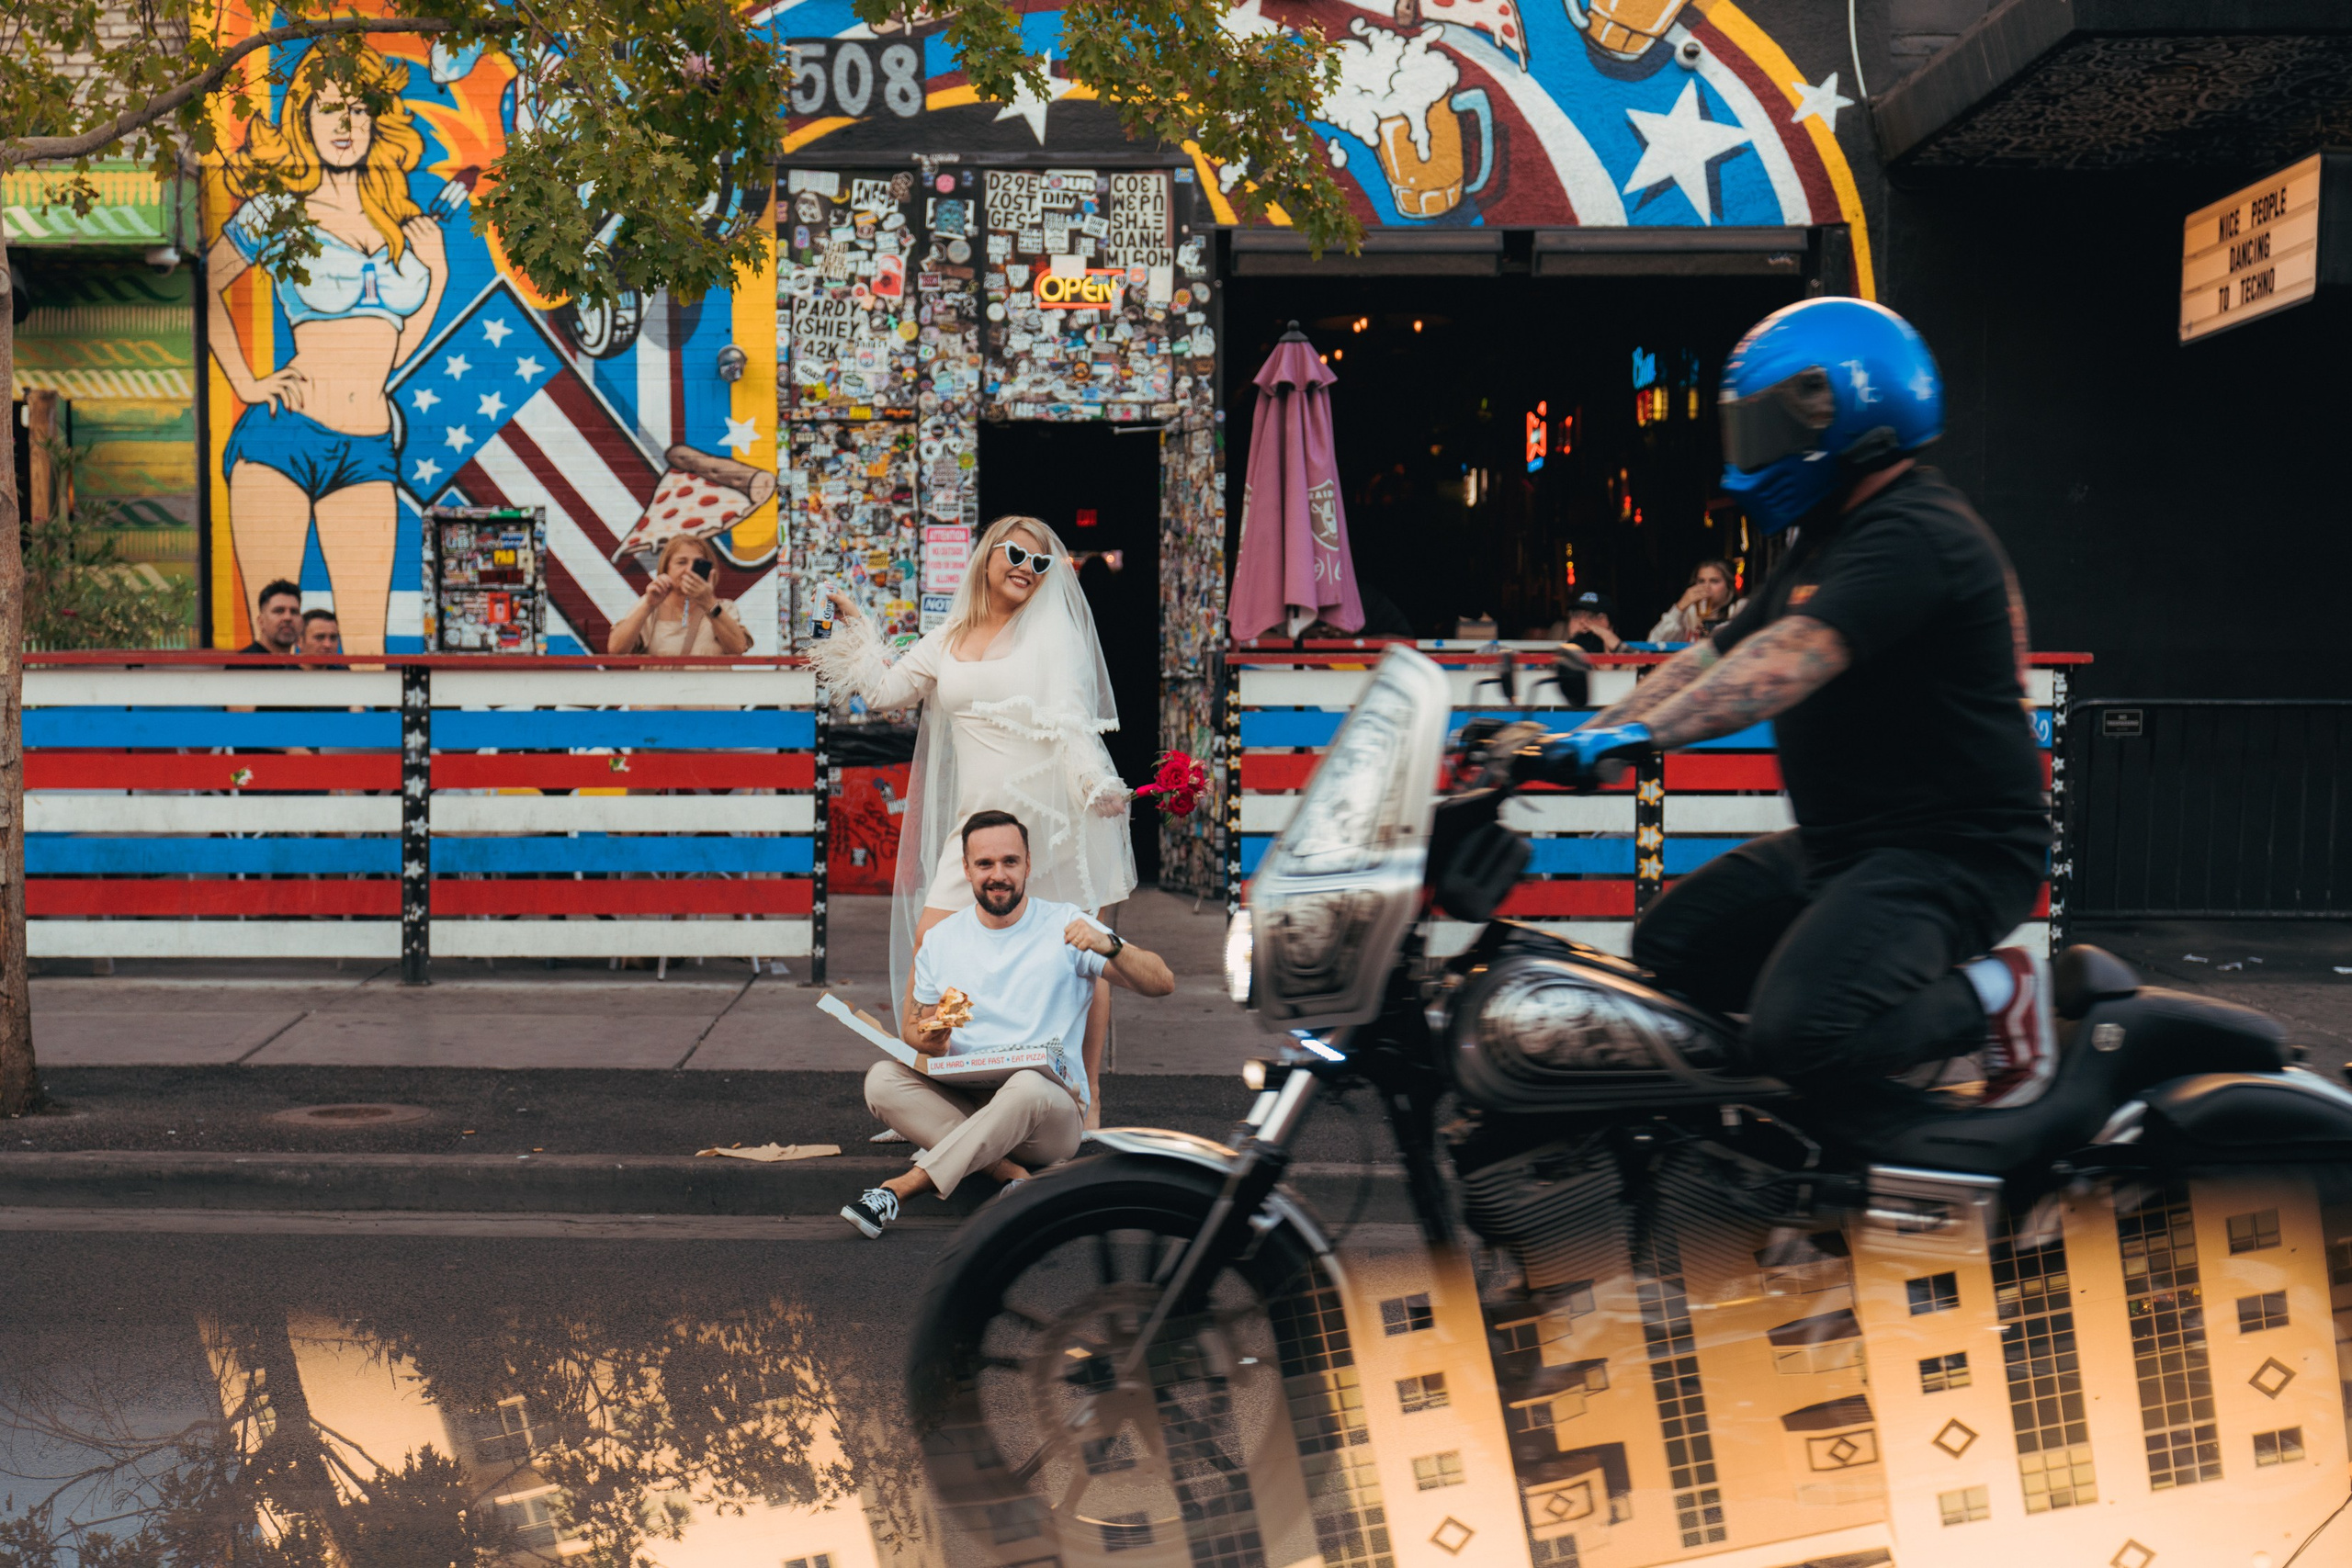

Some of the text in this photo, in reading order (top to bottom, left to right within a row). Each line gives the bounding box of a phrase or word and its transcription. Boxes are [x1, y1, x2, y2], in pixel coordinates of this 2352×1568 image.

[790, 41, 924, 118] 508
[2219, 186, 2287, 243] NICE PEOPLE
[2230, 231, 2270, 273] DANCING
[1039, 275, 1118, 302] OPEN
[2219, 267, 2275, 313] TO TECHNO
[930, 1053, 1046, 1070] LIVE HARD RIDE FAST EAT PIZZA
